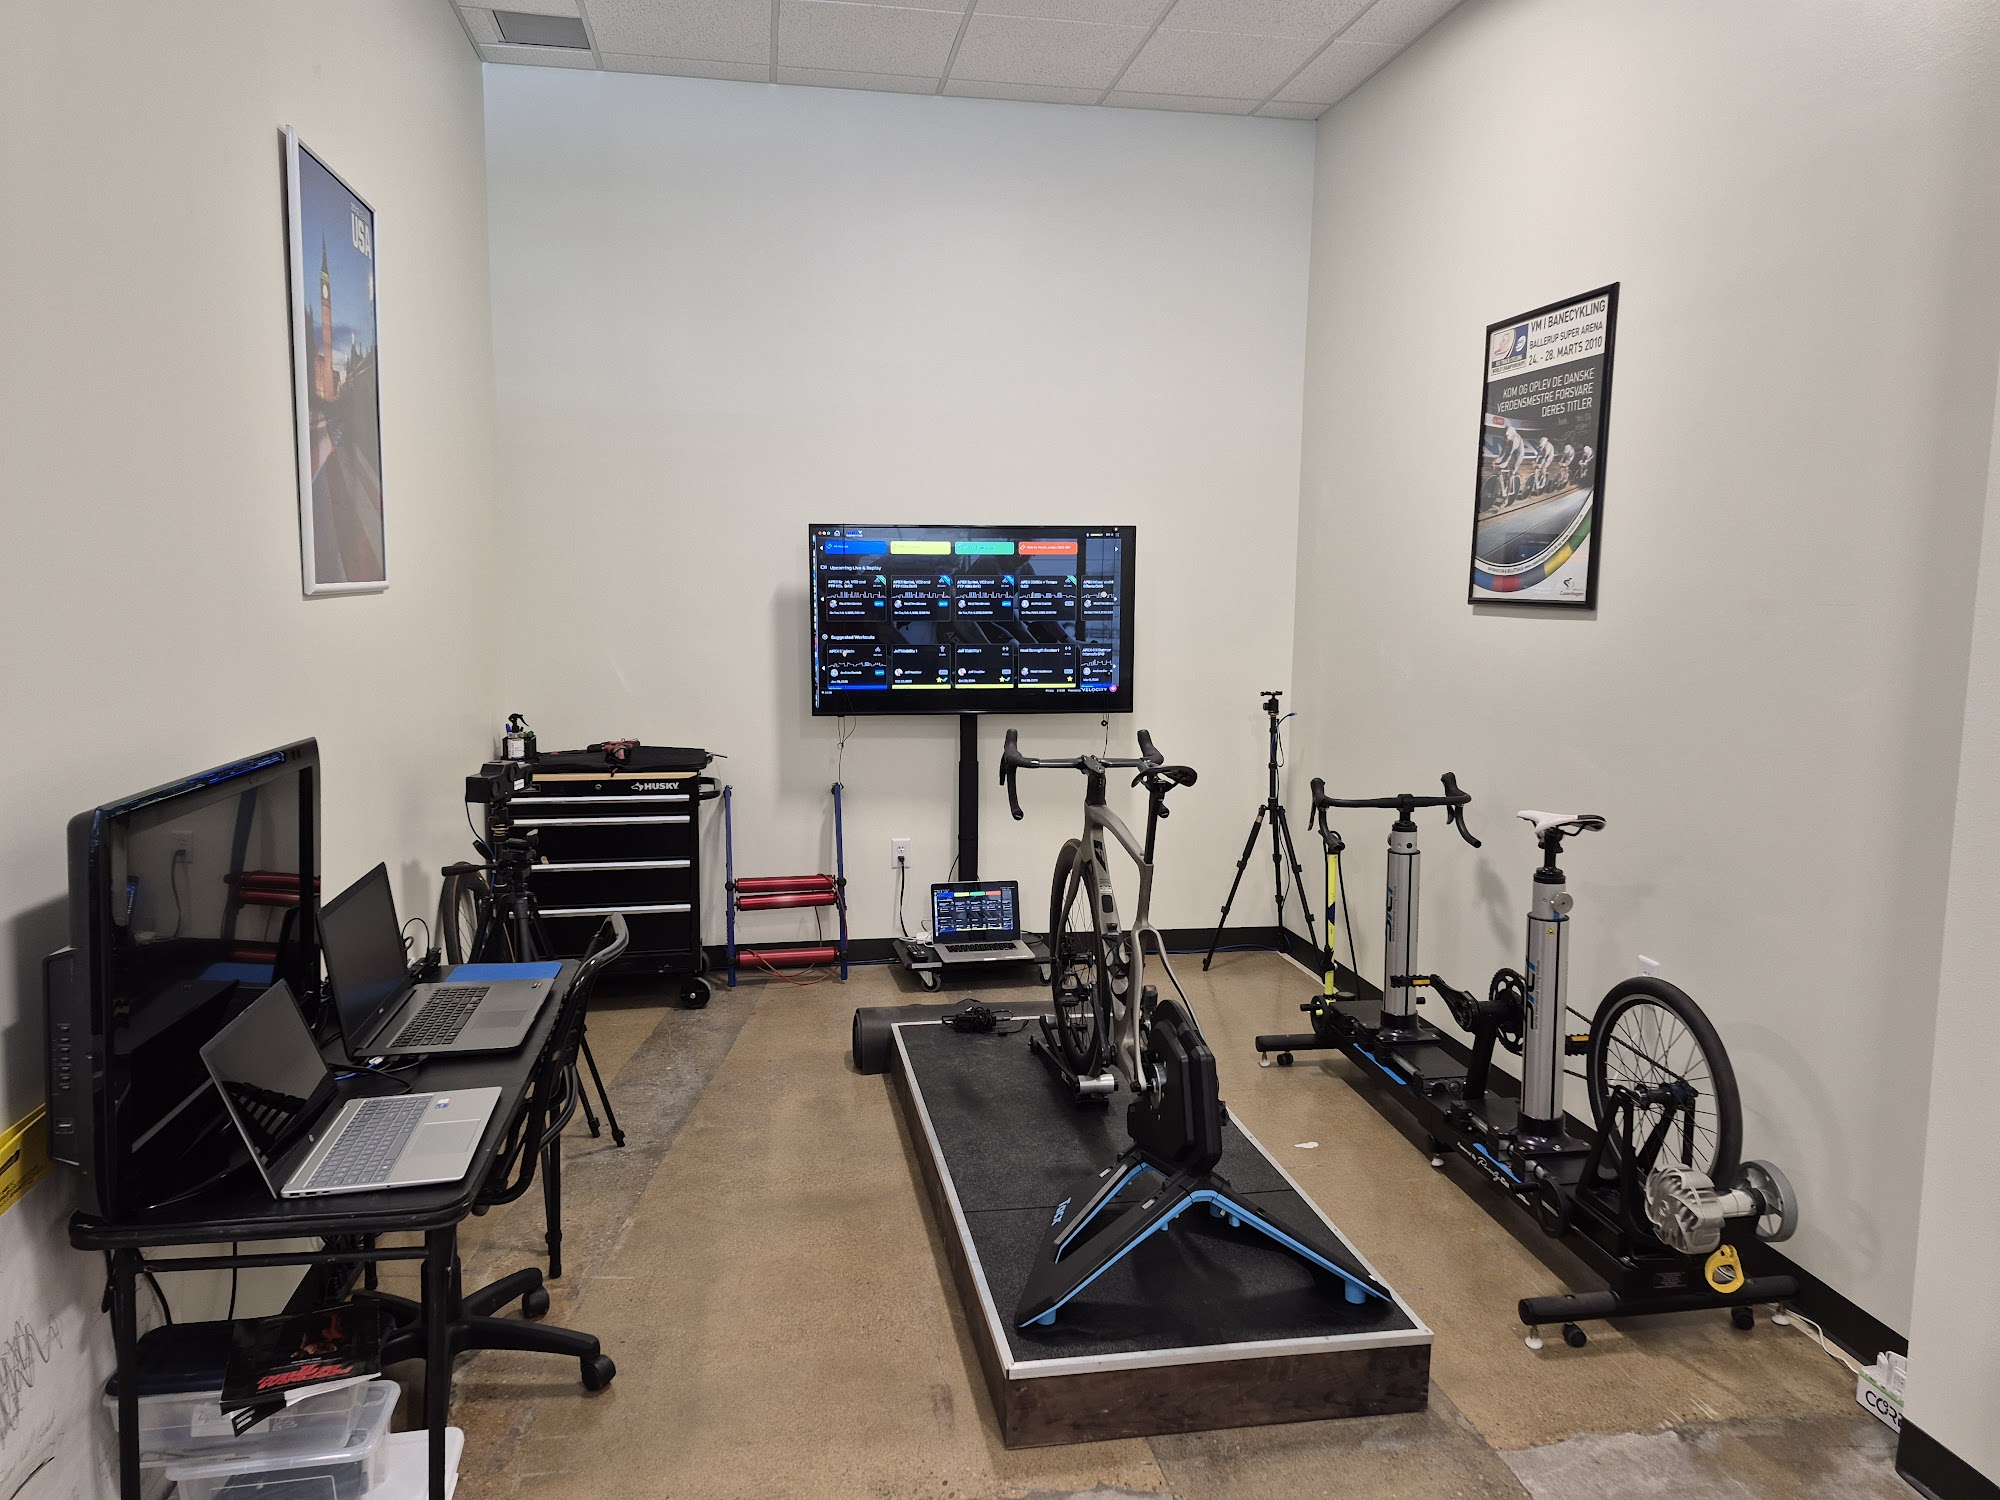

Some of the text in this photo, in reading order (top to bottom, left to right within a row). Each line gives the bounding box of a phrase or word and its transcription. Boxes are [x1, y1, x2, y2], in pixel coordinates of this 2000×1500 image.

[351, 212, 372, 260] USA
[1531, 319, 1542, 332] VM
[1548, 300, 1606, 328] BANECYKLING
[1529, 321, 1603, 349] BALLERUP SUPER ARENA
[1545, 349, 1555, 361] 28.
[1557, 341, 1583, 358] MARTS
[1585, 335, 1603, 351] 2010
[1503, 367, 1595, 398] KOM OG OPLEV DE DANSKE
[1497, 382, 1594, 413] VERDENSMESTRE FORSVARE
[1541, 397, 1593, 417] DERES TITLER
[644, 782, 680, 790] HUSKY
